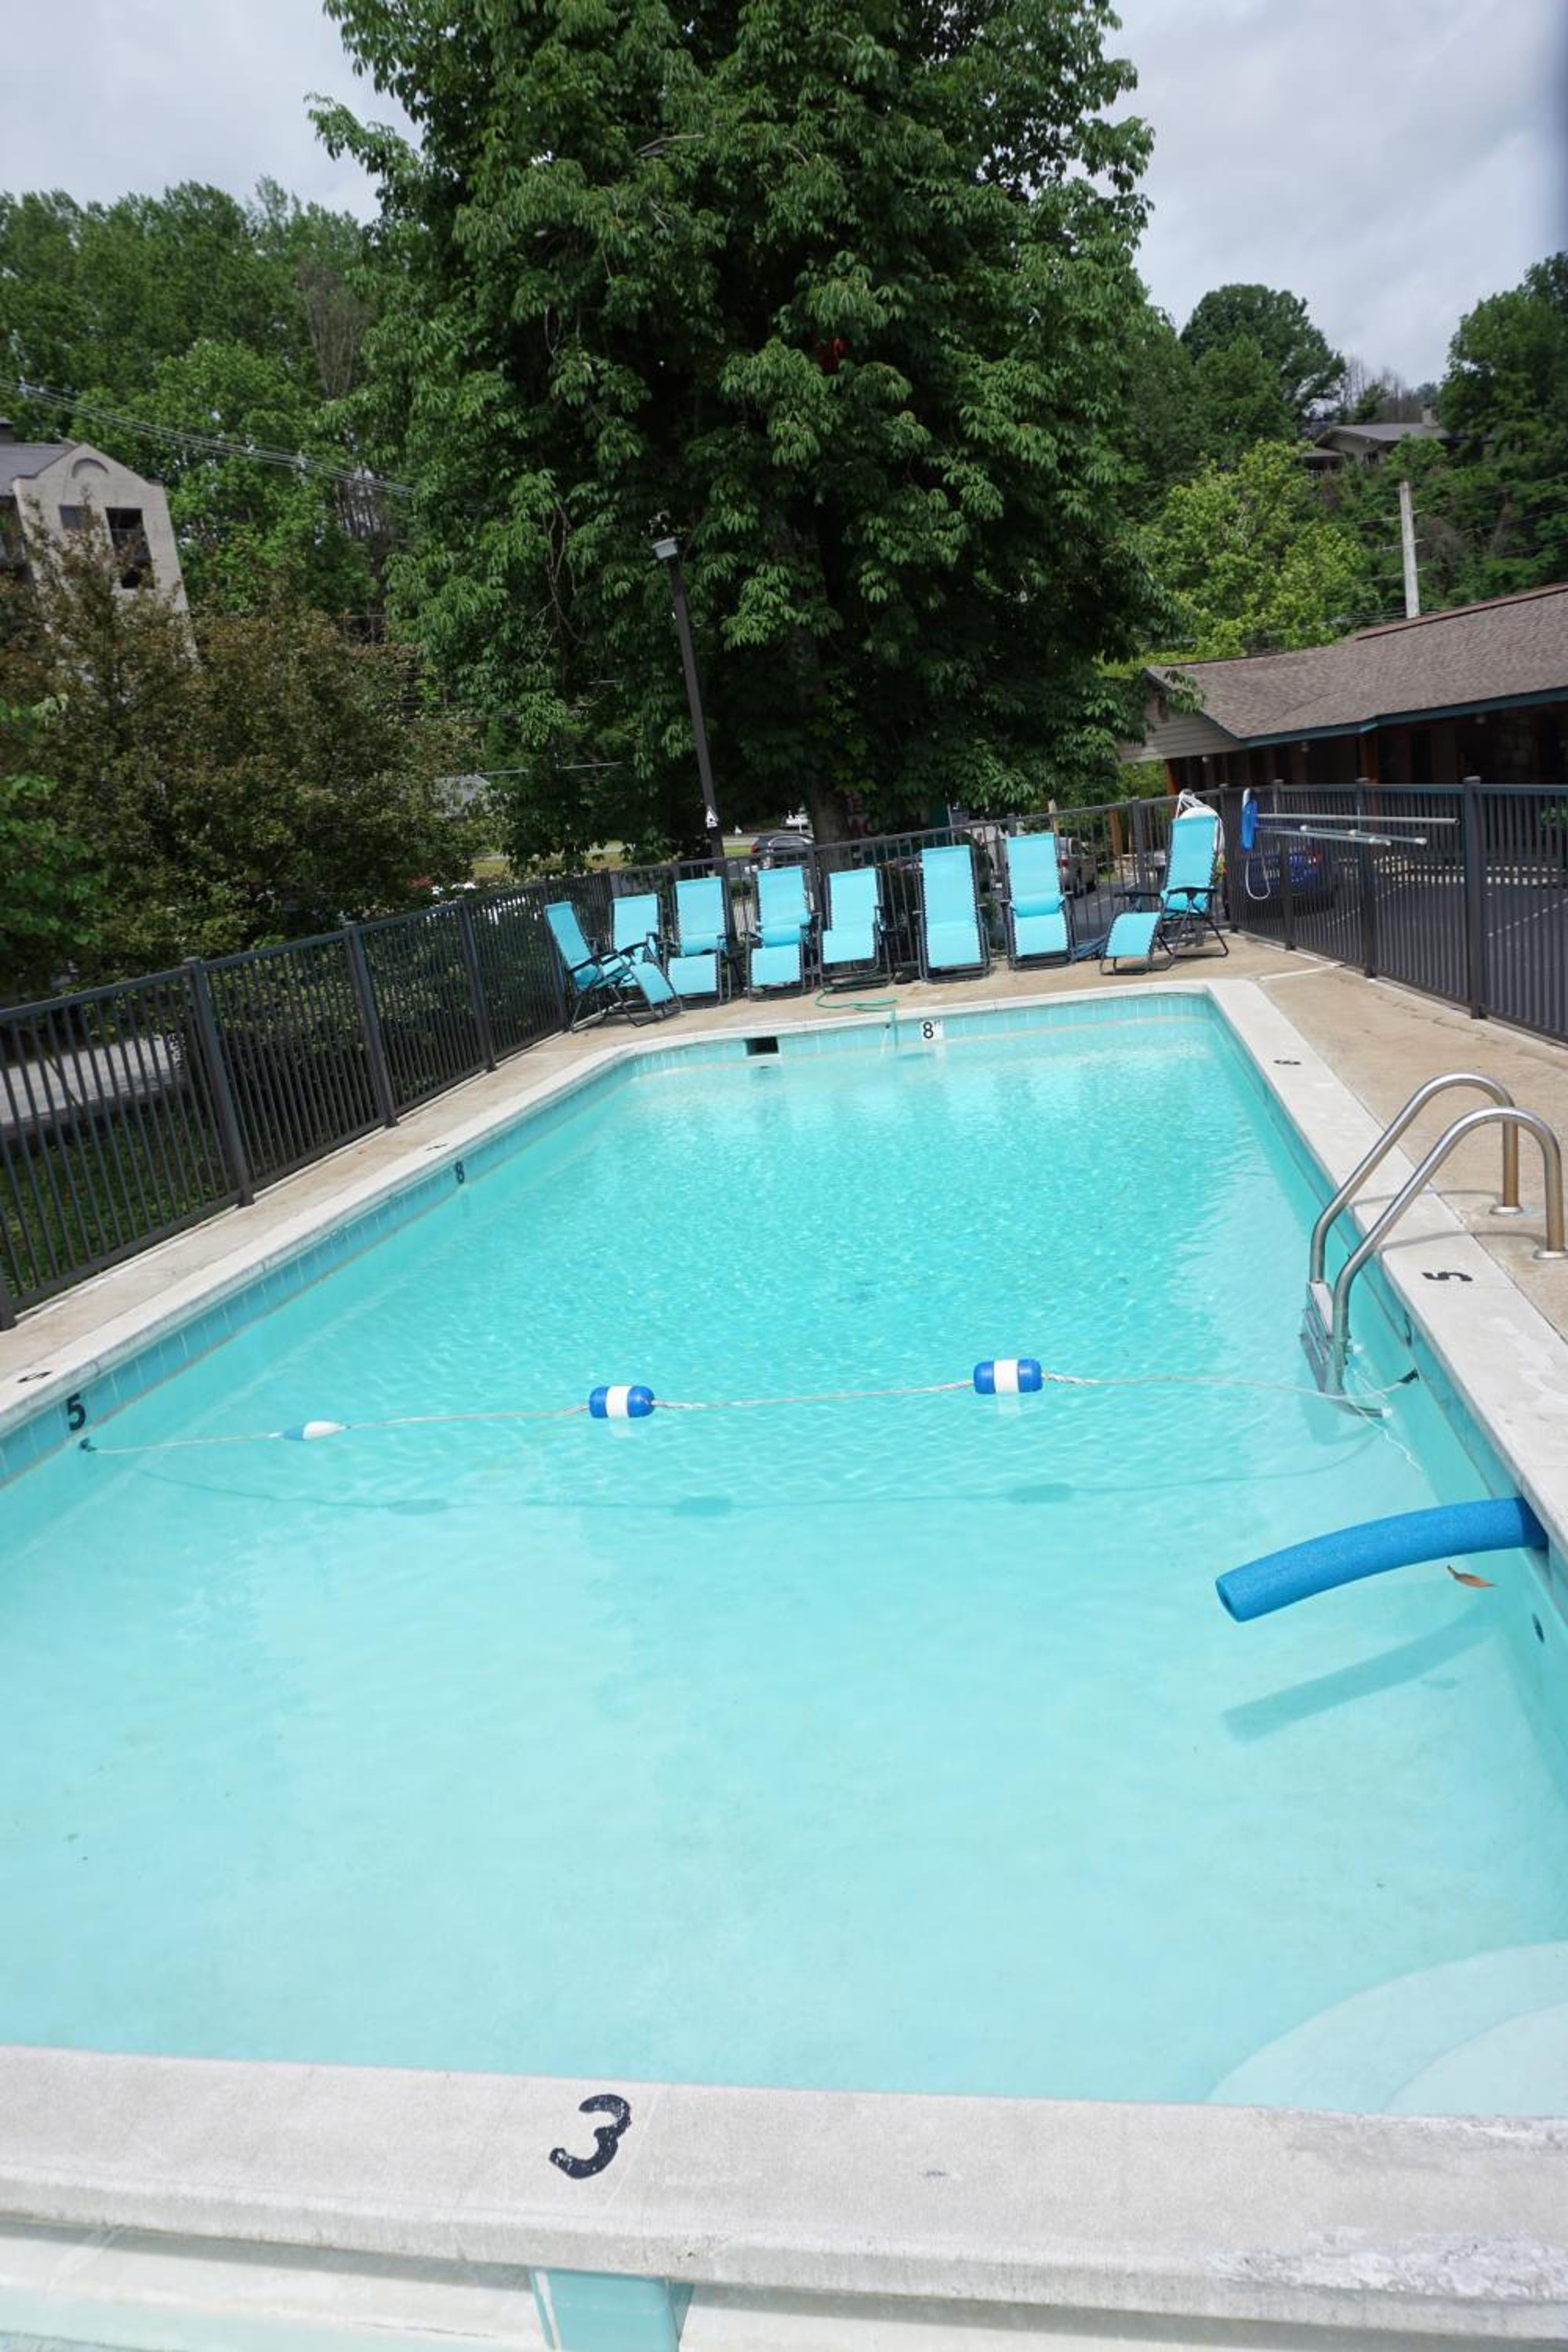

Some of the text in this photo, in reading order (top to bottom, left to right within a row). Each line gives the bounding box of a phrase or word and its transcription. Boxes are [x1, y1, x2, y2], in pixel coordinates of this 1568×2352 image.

[923, 1022, 934, 1039] 8
[456, 1161, 465, 1185] 8
[66, 1392, 86, 1431] 5
[549, 2094, 632, 2180] 3
